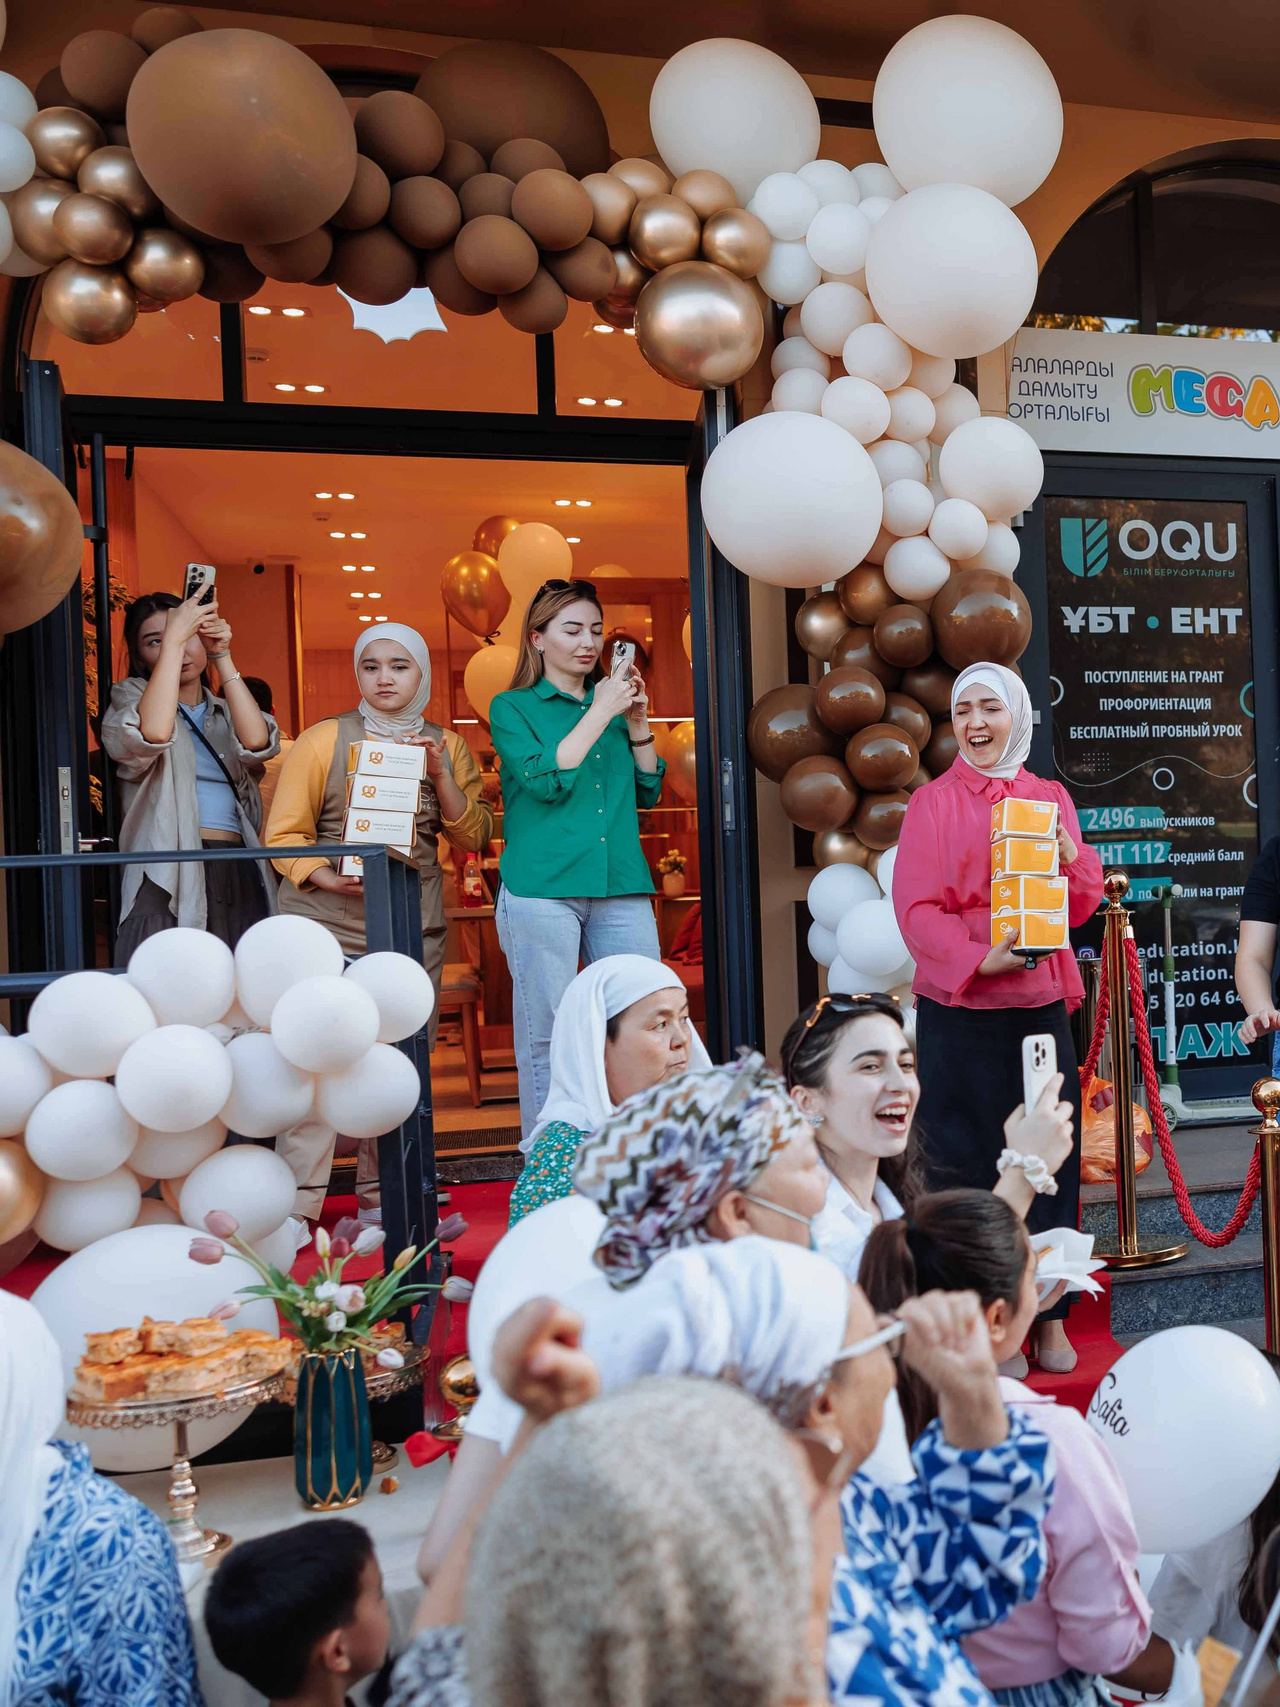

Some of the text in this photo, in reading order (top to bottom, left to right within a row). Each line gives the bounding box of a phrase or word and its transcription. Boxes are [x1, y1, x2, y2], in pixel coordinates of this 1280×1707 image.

[1018, 380, 1097, 400] ДАМЫТУ
[1118, 519, 1238, 562] OQU
[1154, 568, 1179, 577] БЕРУ
[1171, 607, 1243, 634] ЕНТ
[1084, 670, 1224, 684] ПОСТУПЛЕНИЕ НА ГРАНТ
[1099, 697, 1212, 713] ПРОФОРИЕНТАЦИЯ
[1069, 722, 1243, 739] БЕСПЛАТНЫЙ ПРОБНЫЙ УРОК
[1087, 807, 1215, 830] 2496 выпускников
[1093, 842, 1245, 866] НТ 112 средний балл
[1200, 888, 1214, 897] на
[1215, 886, 1245, 899] грант
[1200, 991, 1221, 1006] 64
